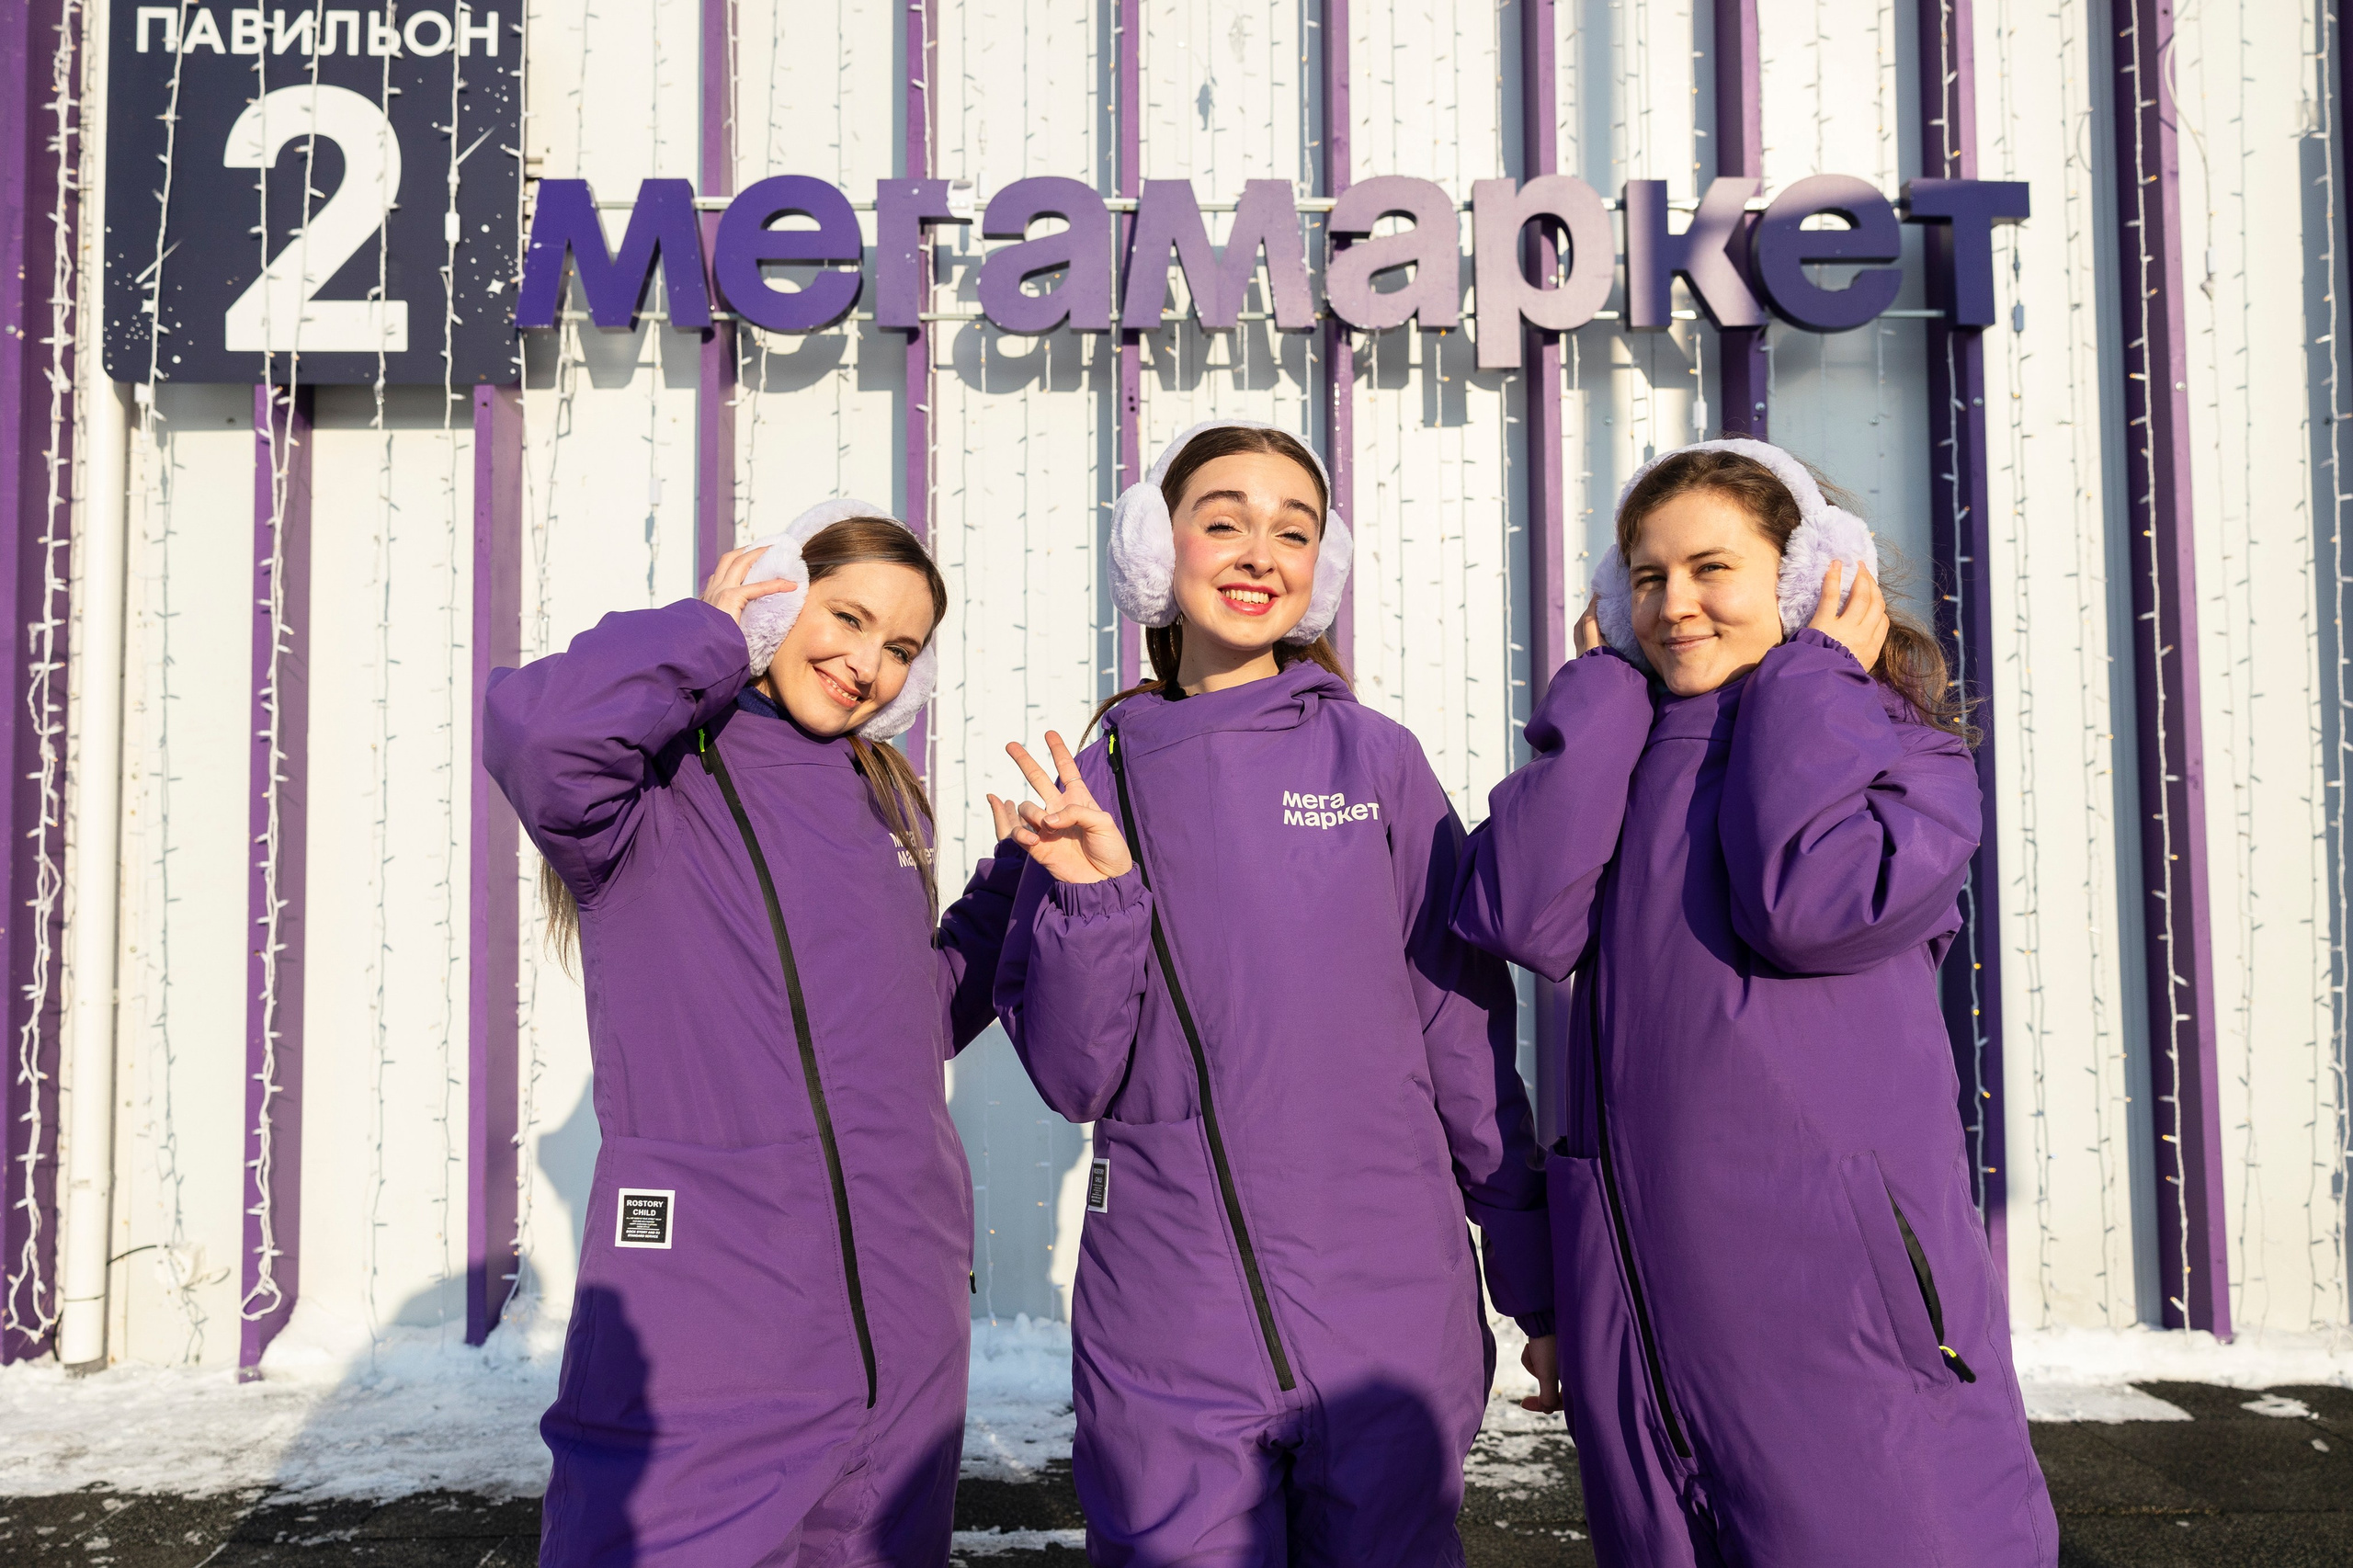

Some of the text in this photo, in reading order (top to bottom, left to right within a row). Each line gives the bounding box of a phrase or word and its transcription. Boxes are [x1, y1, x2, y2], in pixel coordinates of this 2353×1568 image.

[136, 6, 499, 57] ПАВИЛЬОН
[223, 84, 408, 352] 2
[516, 174, 2030, 369] мегамаркет
[626, 1199, 664, 1208] ROSTORY
